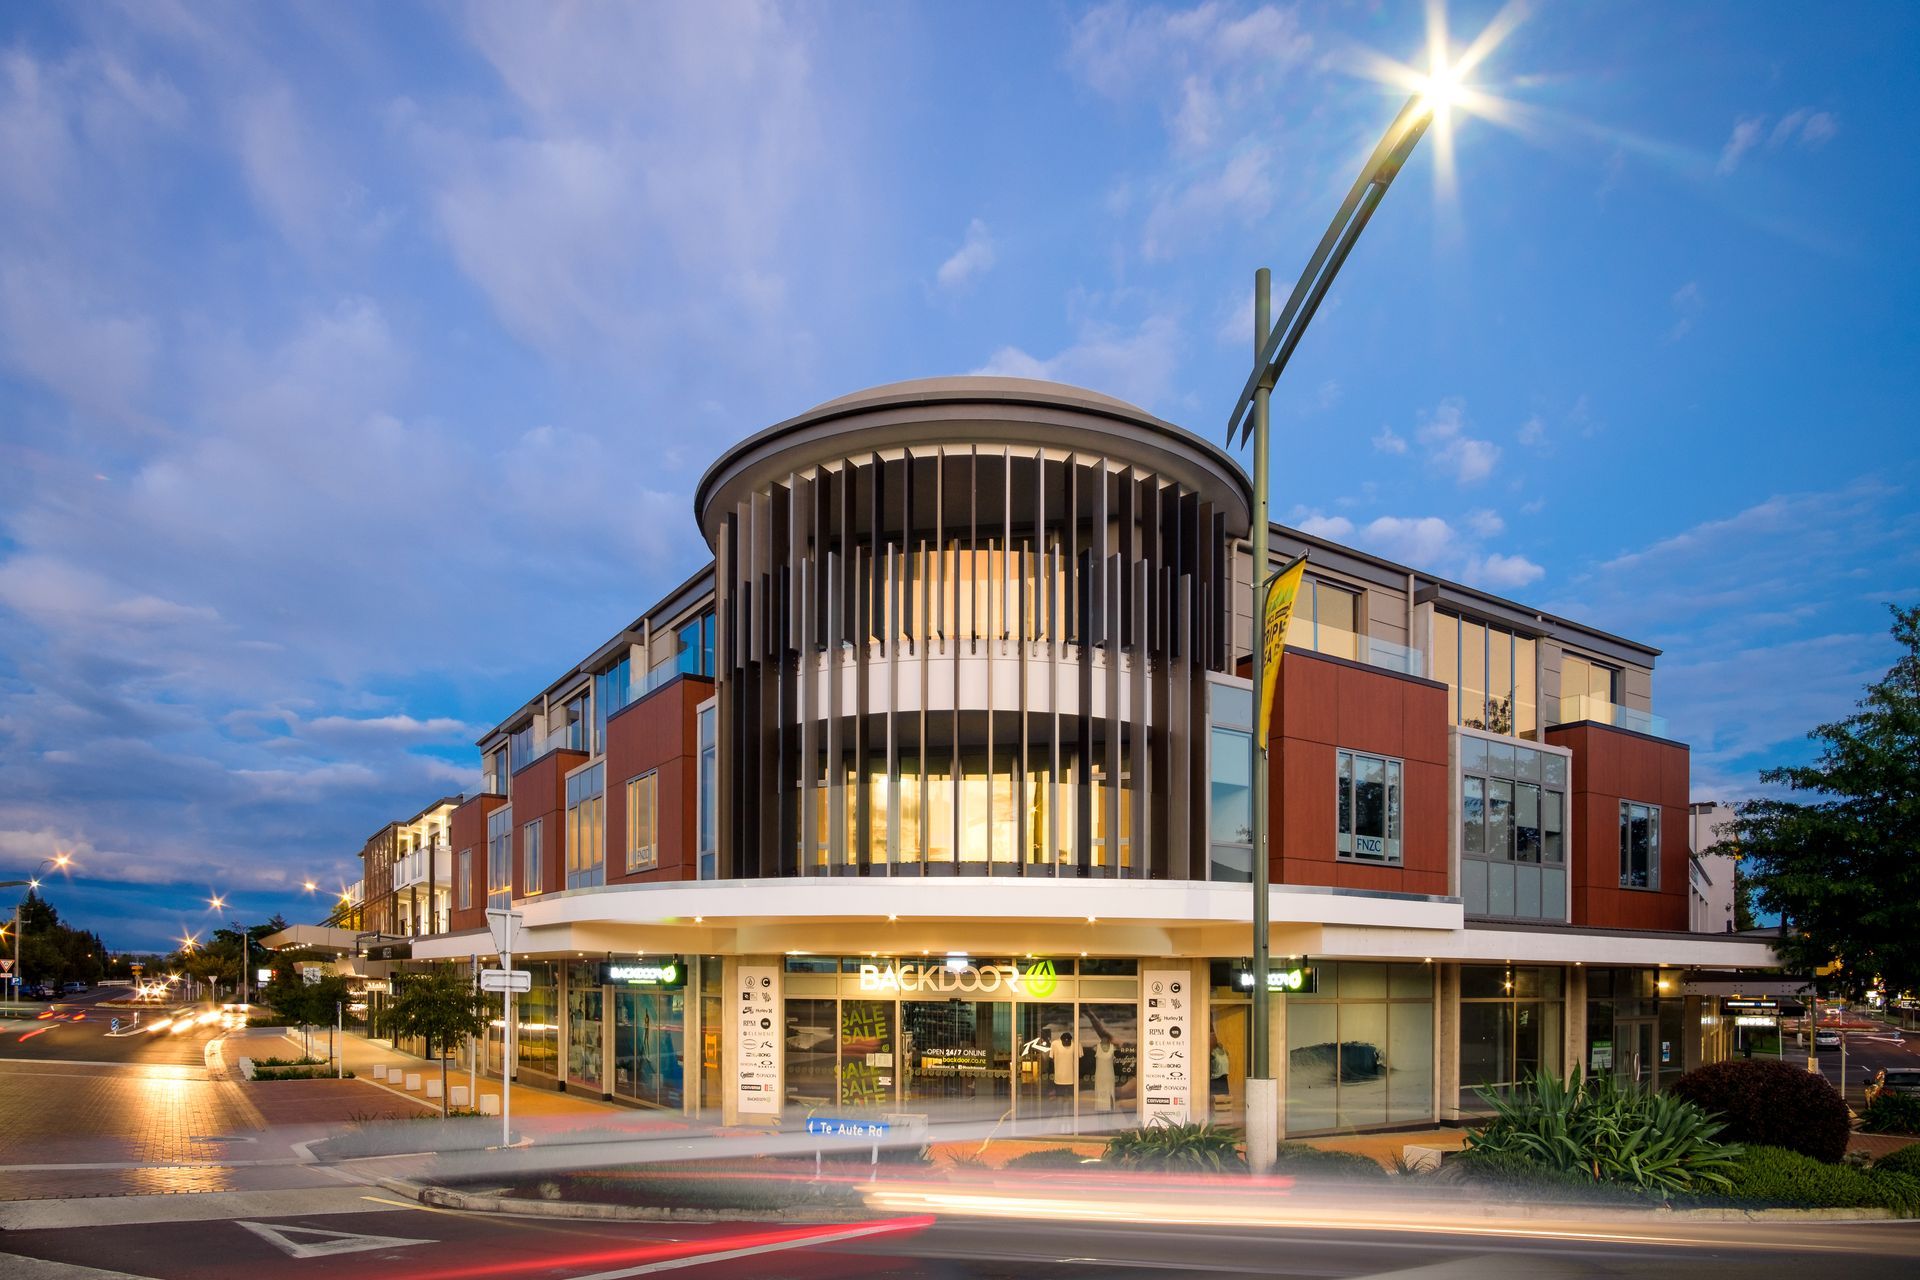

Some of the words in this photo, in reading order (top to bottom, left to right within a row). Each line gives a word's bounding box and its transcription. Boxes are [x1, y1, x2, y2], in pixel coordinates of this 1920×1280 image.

[1357, 837, 1381, 852] FNZC
[860, 964, 1020, 993] BACKDOOR
[842, 1003, 886, 1028] SALE
[842, 1022, 888, 1045] SALE
[942, 1056, 986, 1064] backdoor.co.nz
[842, 1074, 886, 1098] SALE
[820, 1122, 832, 1134] Te
[837, 1123, 863, 1136] Aute
[868, 1125, 882, 1137] Rd
